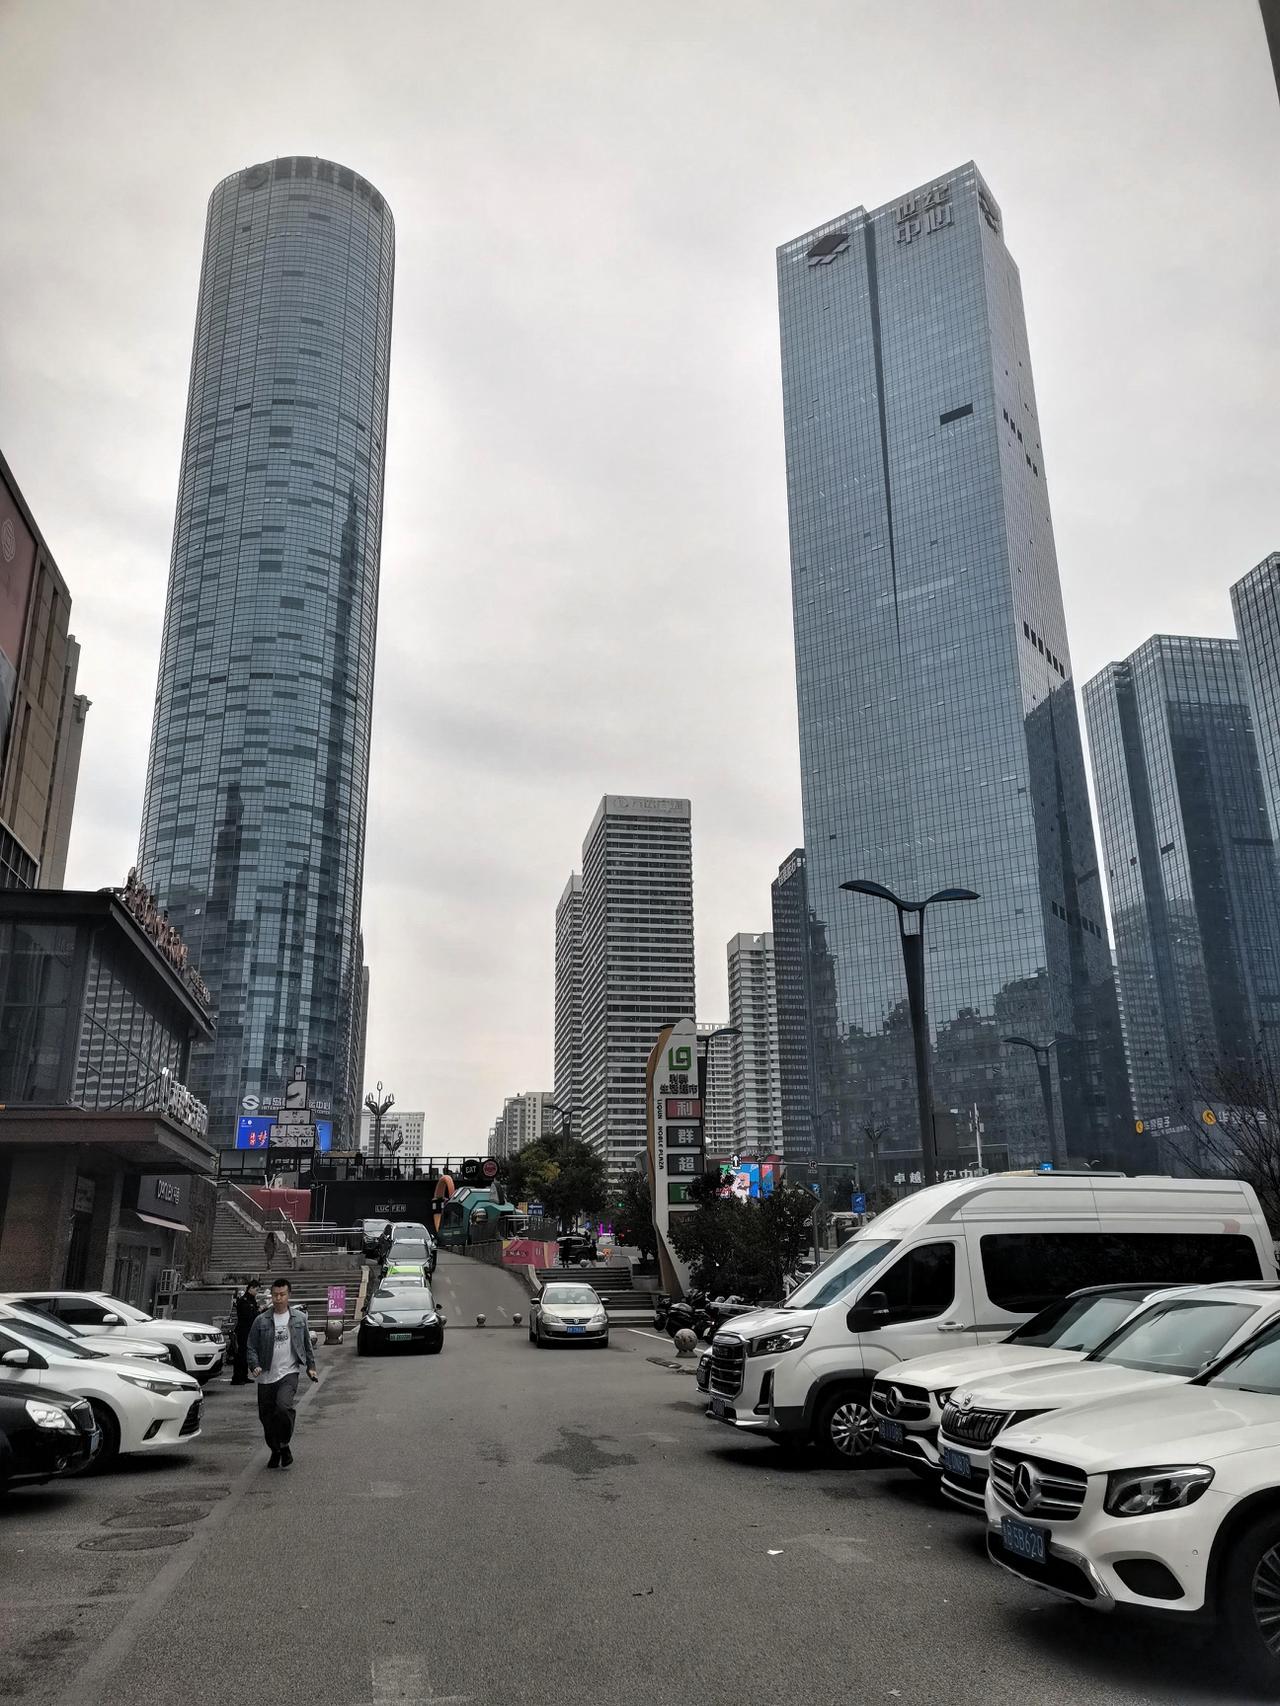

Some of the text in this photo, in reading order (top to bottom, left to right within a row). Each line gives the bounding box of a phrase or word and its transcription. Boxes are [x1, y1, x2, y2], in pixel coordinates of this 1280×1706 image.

[896, 182, 951, 223] 世纪
[896, 203, 955, 244] 中心
[659, 1083, 697, 1095] 生活超市
